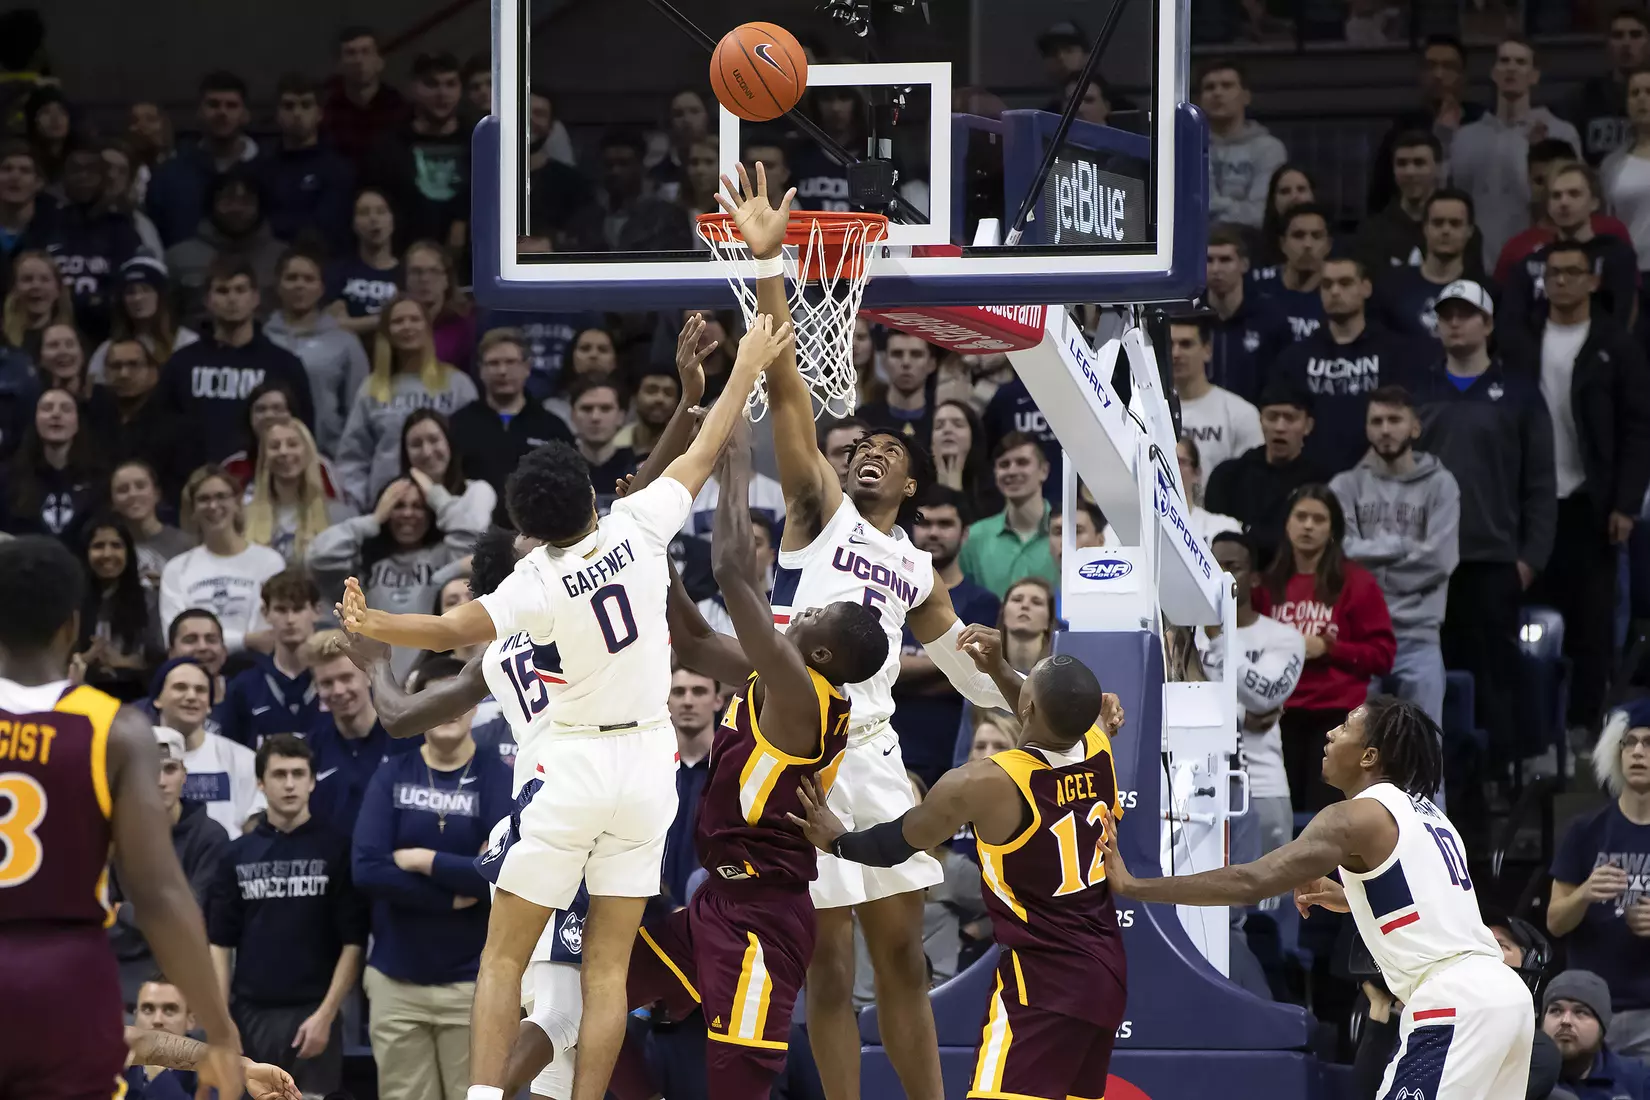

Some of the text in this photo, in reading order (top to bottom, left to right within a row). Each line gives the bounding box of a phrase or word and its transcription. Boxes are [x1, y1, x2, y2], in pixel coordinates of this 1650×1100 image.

[732, 69, 754, 100] UCONN
[1054, 156, 1125, 244] jetBlue
[1069, 337, 1112, 409] LEGACY
[1307, 354, 1379, 379] UCONN
[561, 538, 636, 599] GAFFNEY
[1169, 505, 1212, 580] SPORTS
[831, 545, 919, 609] UCONN
[590, 583, 639, 654] 0
[1271, 600, 1334, 622] UCONN
[500, 649, 550, 724] 15
[400, 786, 473, 812] UCONN
[1057, 772, 1097, 807] AGEE
[1049, 800, 1109, 897] 12
[1423, 821, 1472, 892] 10
